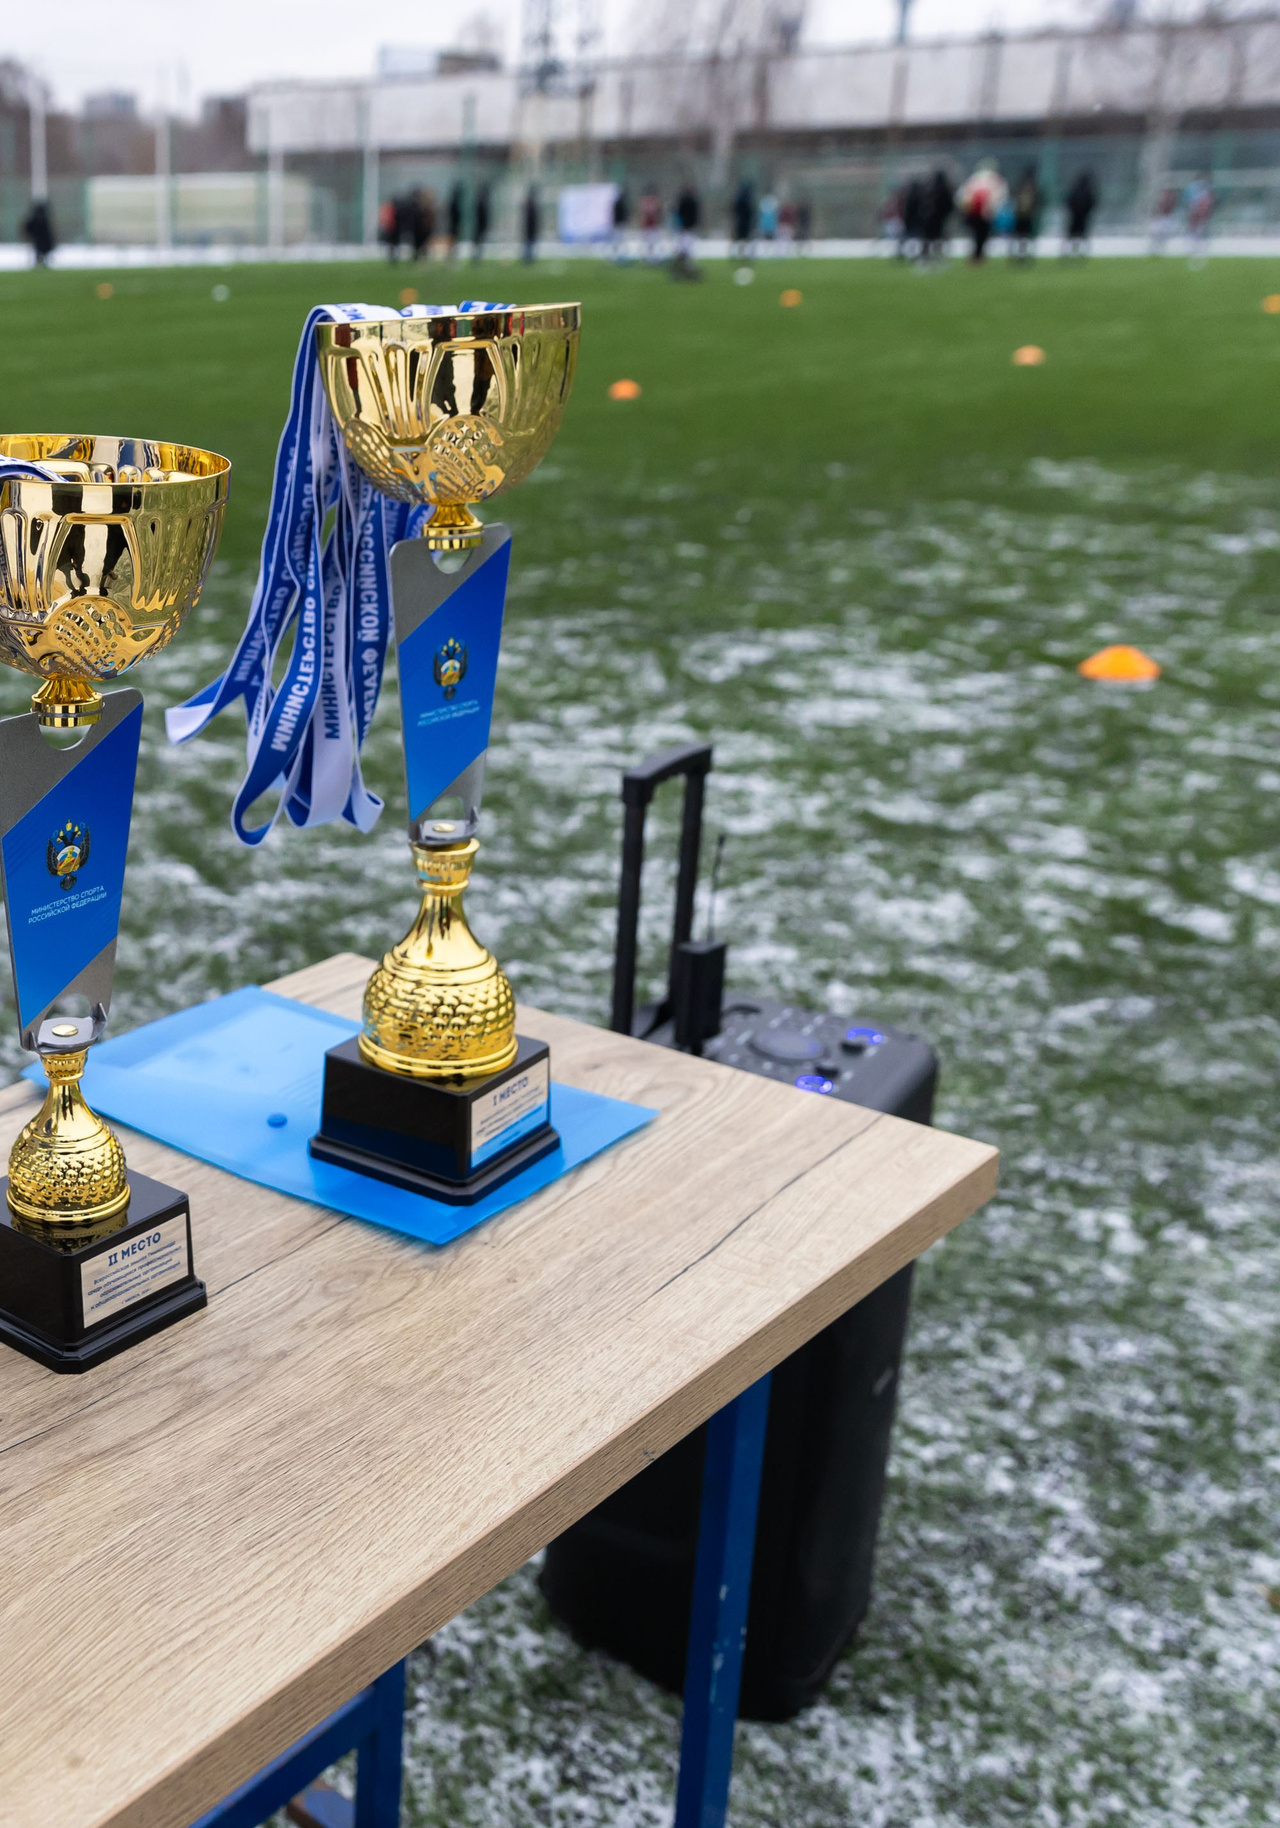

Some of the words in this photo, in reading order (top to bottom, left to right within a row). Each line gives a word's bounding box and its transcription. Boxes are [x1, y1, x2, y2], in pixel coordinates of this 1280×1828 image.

[28, 904, 71, 925] РОССИЙСКОЙ
[71, 891, 108, 910] ФЕДЕРАЦИИ
[31, 893, 80, 916] МИНИСТЕРСТВО
[80, 885, 105, 899] СПОРТА
[108, 1252, 118, 1267] II
[121, 1232, 162, 1260] МЕСТО
